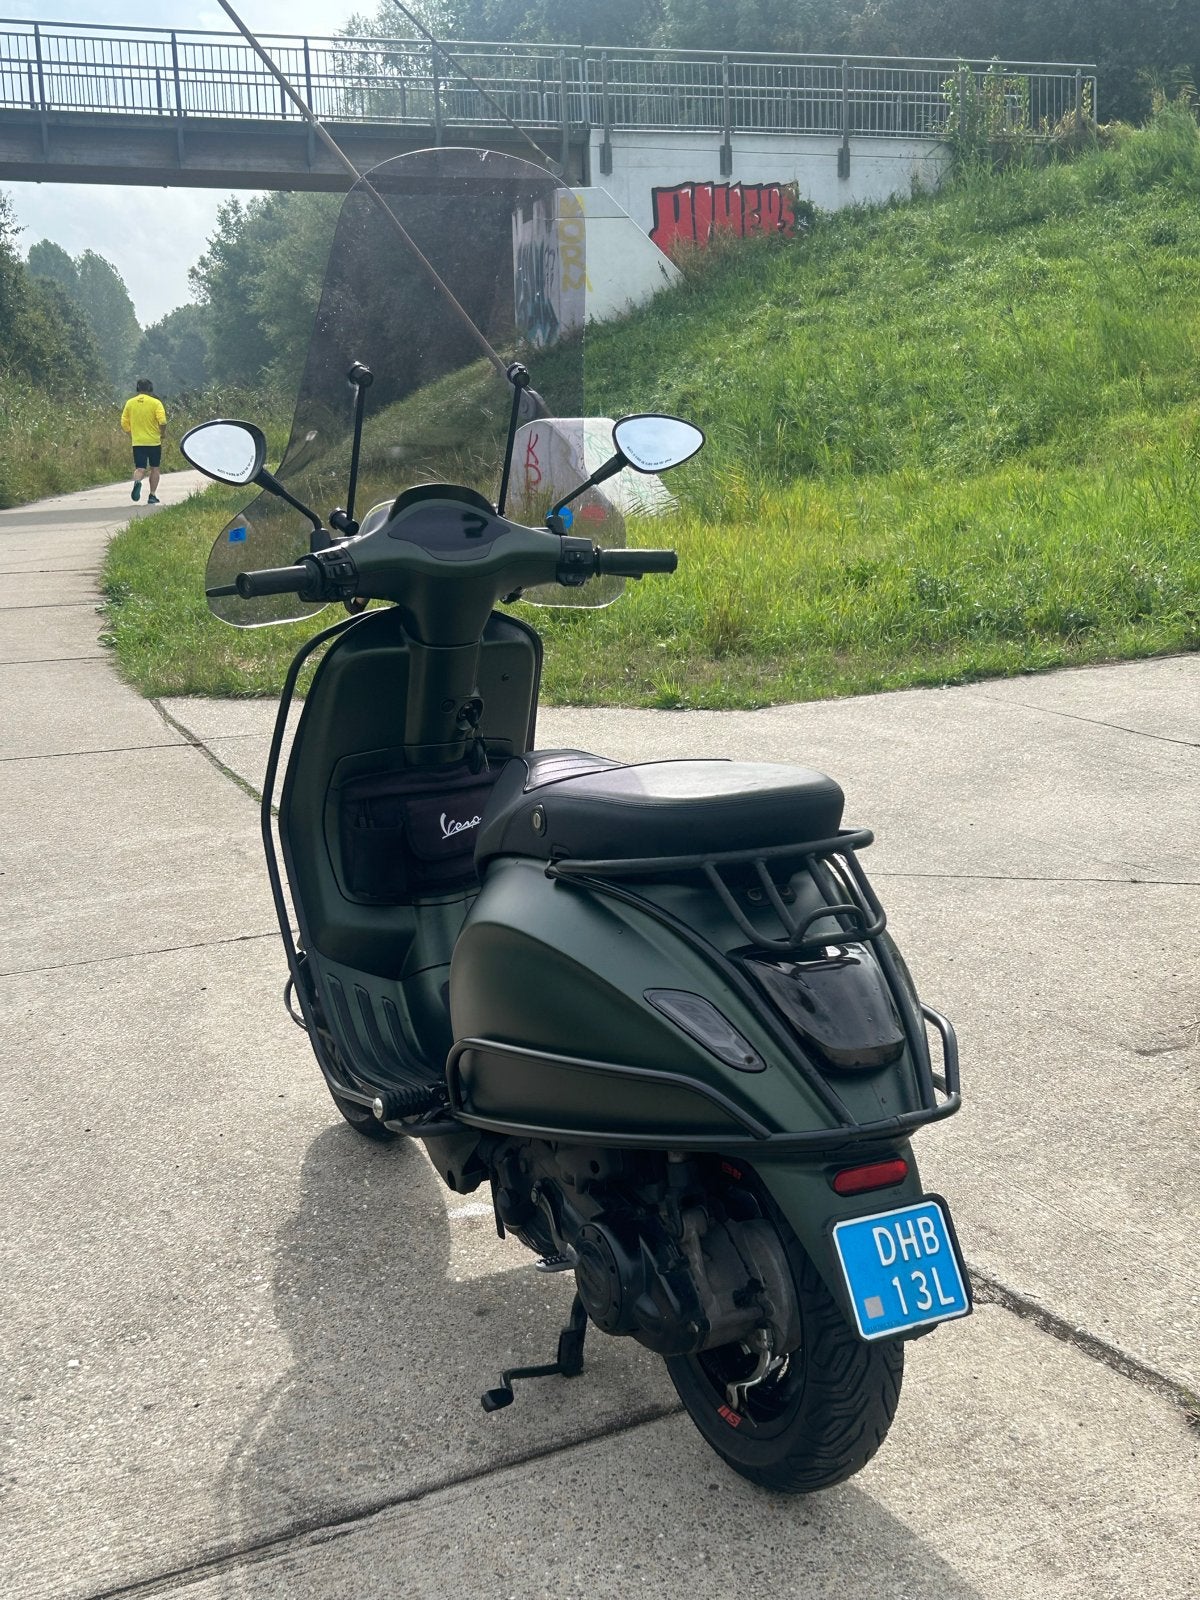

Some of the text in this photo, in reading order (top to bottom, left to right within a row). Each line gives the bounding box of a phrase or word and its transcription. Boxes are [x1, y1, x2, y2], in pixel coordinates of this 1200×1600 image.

[440, 812, 482, 839] Vesp
[872, 1216, 940, 1266] DHB
[892, 1267, 955, 1315] 13L
